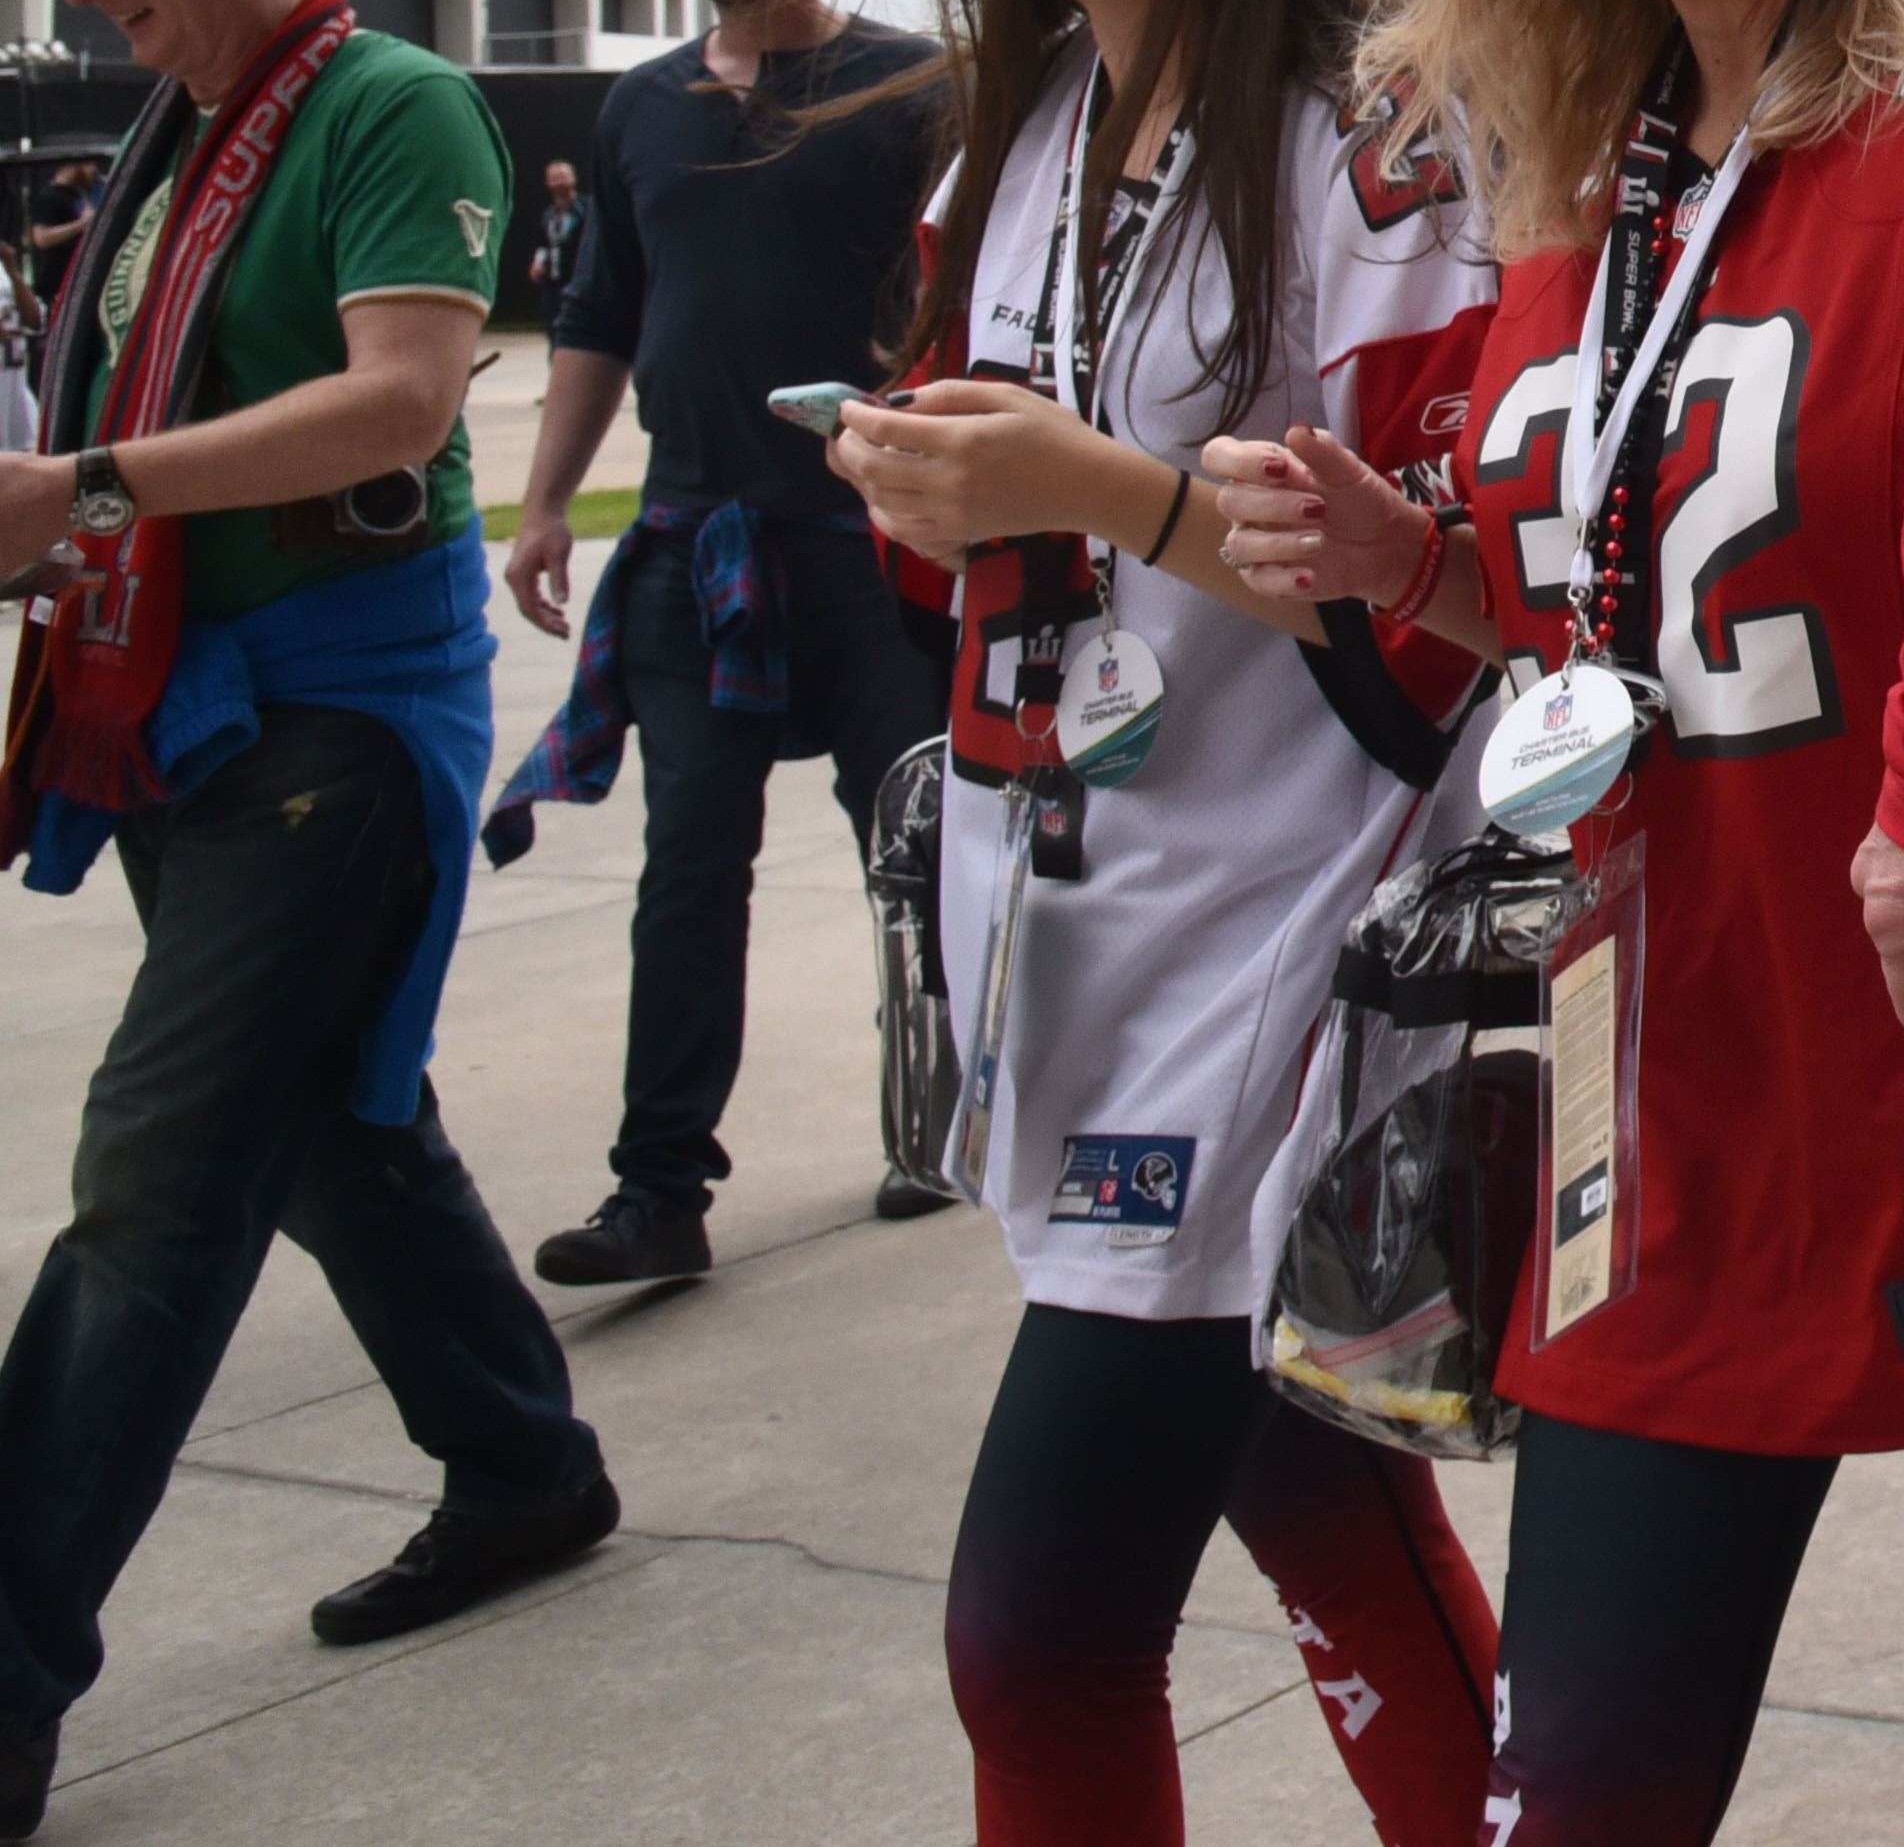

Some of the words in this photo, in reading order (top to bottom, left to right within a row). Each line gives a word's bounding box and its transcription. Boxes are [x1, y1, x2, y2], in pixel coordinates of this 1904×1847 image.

[1624, 229, 1641, 285] SUPER
[1620, 286, 1637, 334] BOWL
[1080, 701, 1140, 726] TERMINAL
[1511, 734, 1596, 771] TERMINAL
[1107, 1149, 1120, 1172] L
